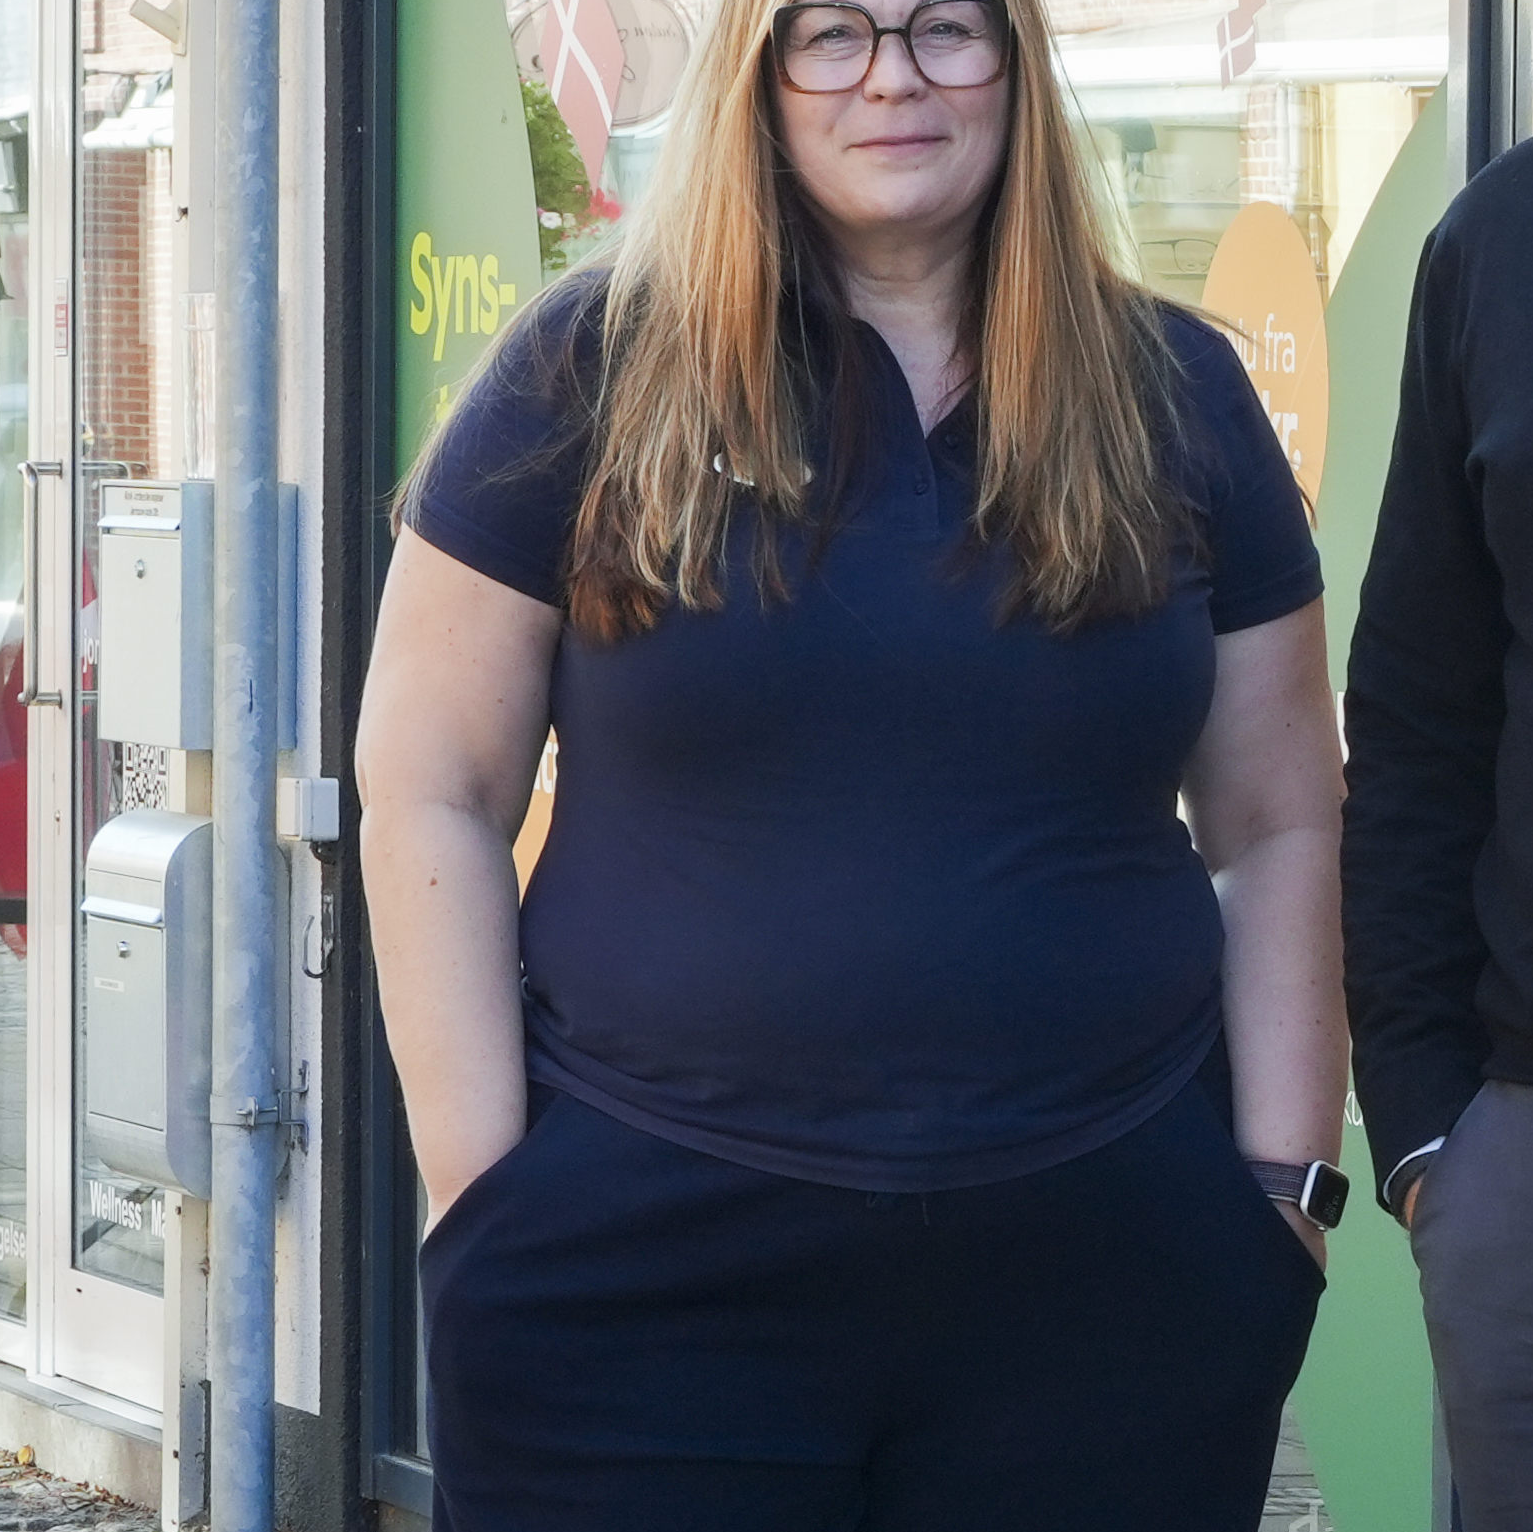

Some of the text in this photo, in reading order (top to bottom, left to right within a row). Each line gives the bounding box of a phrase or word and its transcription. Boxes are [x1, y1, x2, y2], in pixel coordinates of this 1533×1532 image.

[410, 231, 517, 362] Syns-
[1263, 313, 1297, 373] fra
[89, 1179, 143, 1232] Wellness
